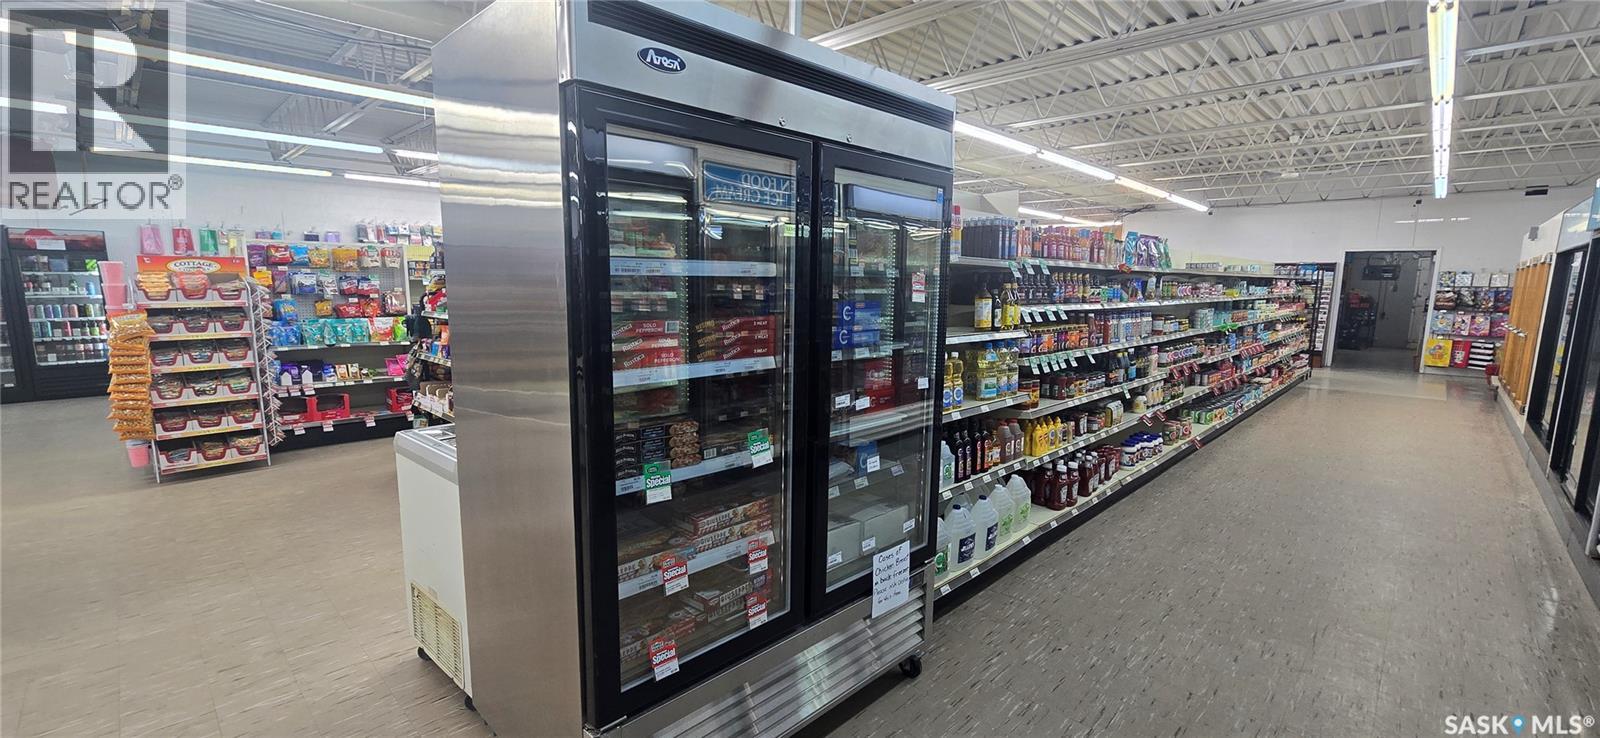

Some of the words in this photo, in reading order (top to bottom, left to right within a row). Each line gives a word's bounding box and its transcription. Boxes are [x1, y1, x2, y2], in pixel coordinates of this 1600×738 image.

[750, 441, 770, 454] Special
[646, 475, 671, 488] Special
[749, 549, 767, 561] Special
[878, 553, 894, 563] Cases
[895, 546, 903, 555] of
[663, 565, 686, 580] Special
[875, 563, 894, 576] Chicken
[748, 602, 767, 616] Special
[652, 648, 676, 664] Special
